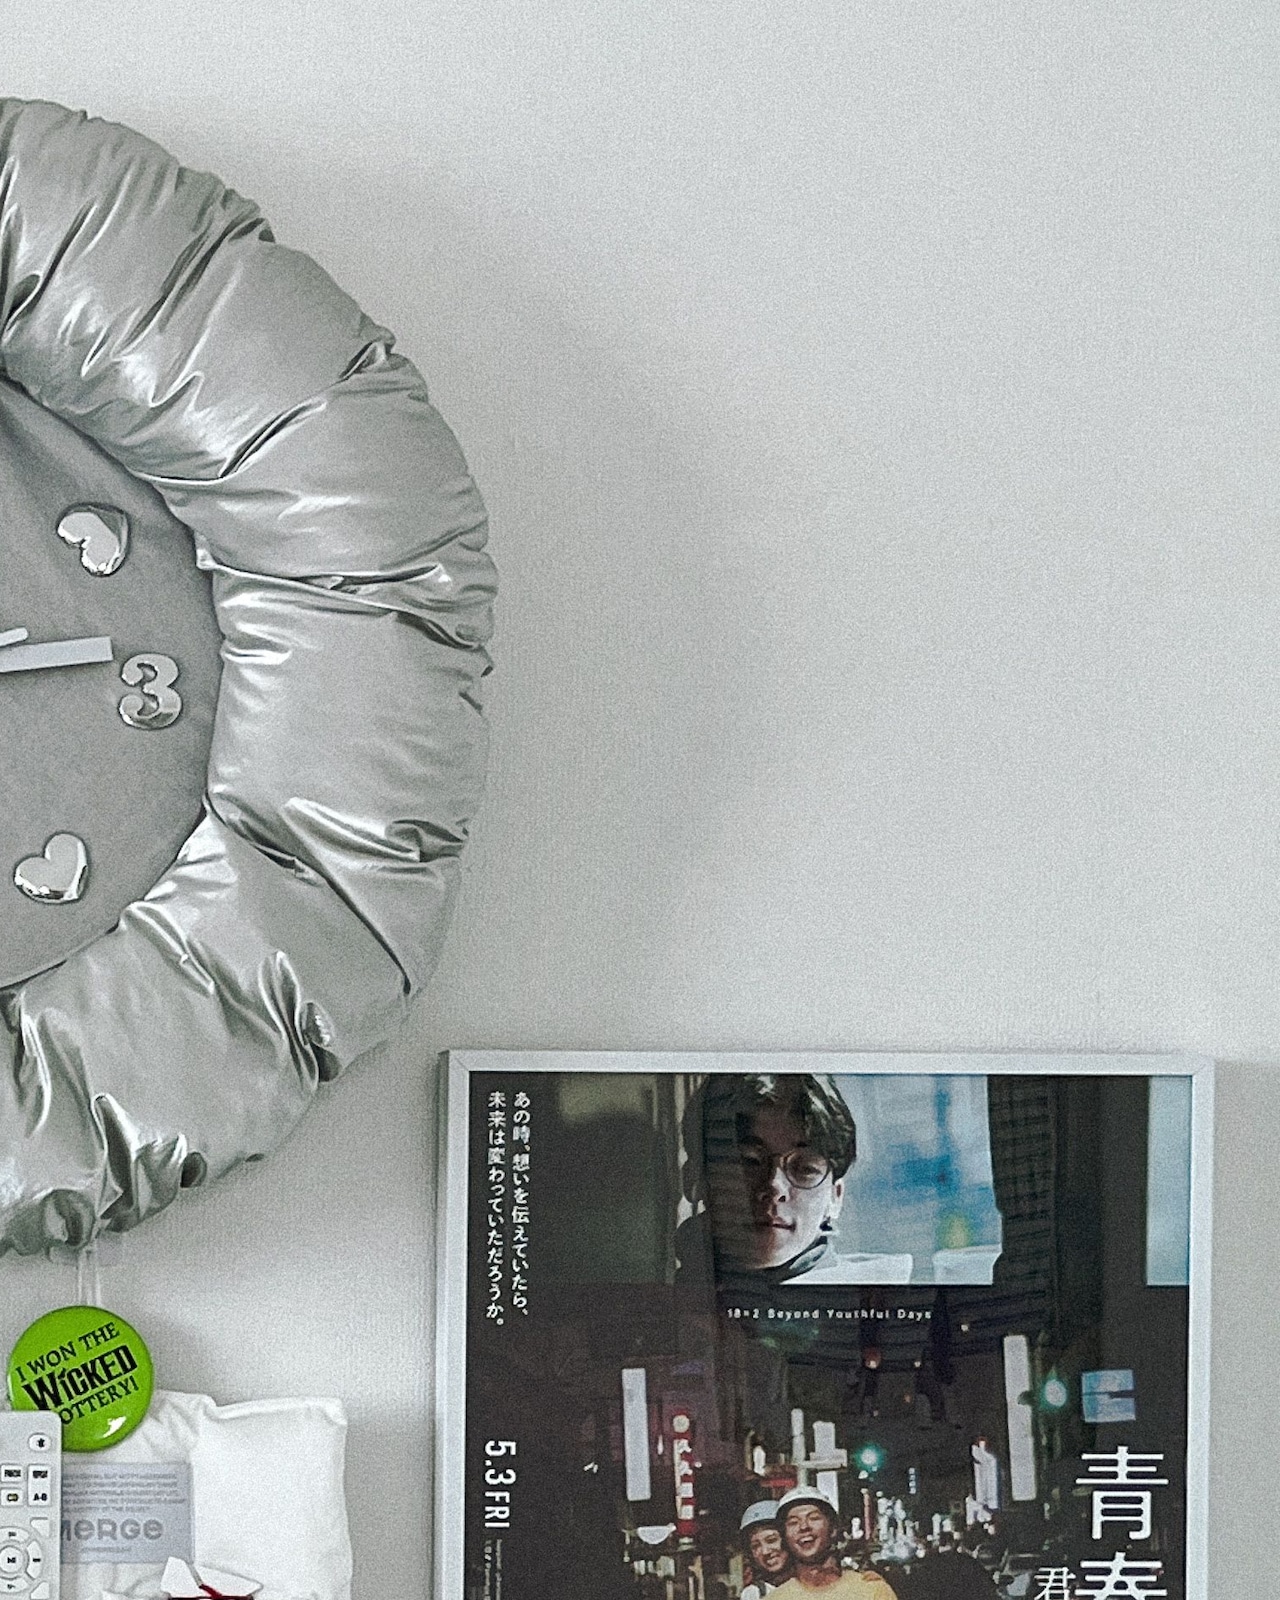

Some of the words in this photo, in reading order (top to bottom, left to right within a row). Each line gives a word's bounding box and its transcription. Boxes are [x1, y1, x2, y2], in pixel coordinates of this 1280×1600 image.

[118, 654, 182, 729] 3
[768, 1309, 819, 1321] Beyond
[827, 1309, 890, 1319] Youthful
[897, 1309, 931, 1321] Days
[16, 1366, 27, 1382] I
[27, 1341, 77, 1376] WON
[79, 1322, 120, 1351] THE
[59, 1375, 139, 1424] OTTERY!
[485, 1441, 516, 1485] 5.3
[485, 1491, 510, 1527] FRI
